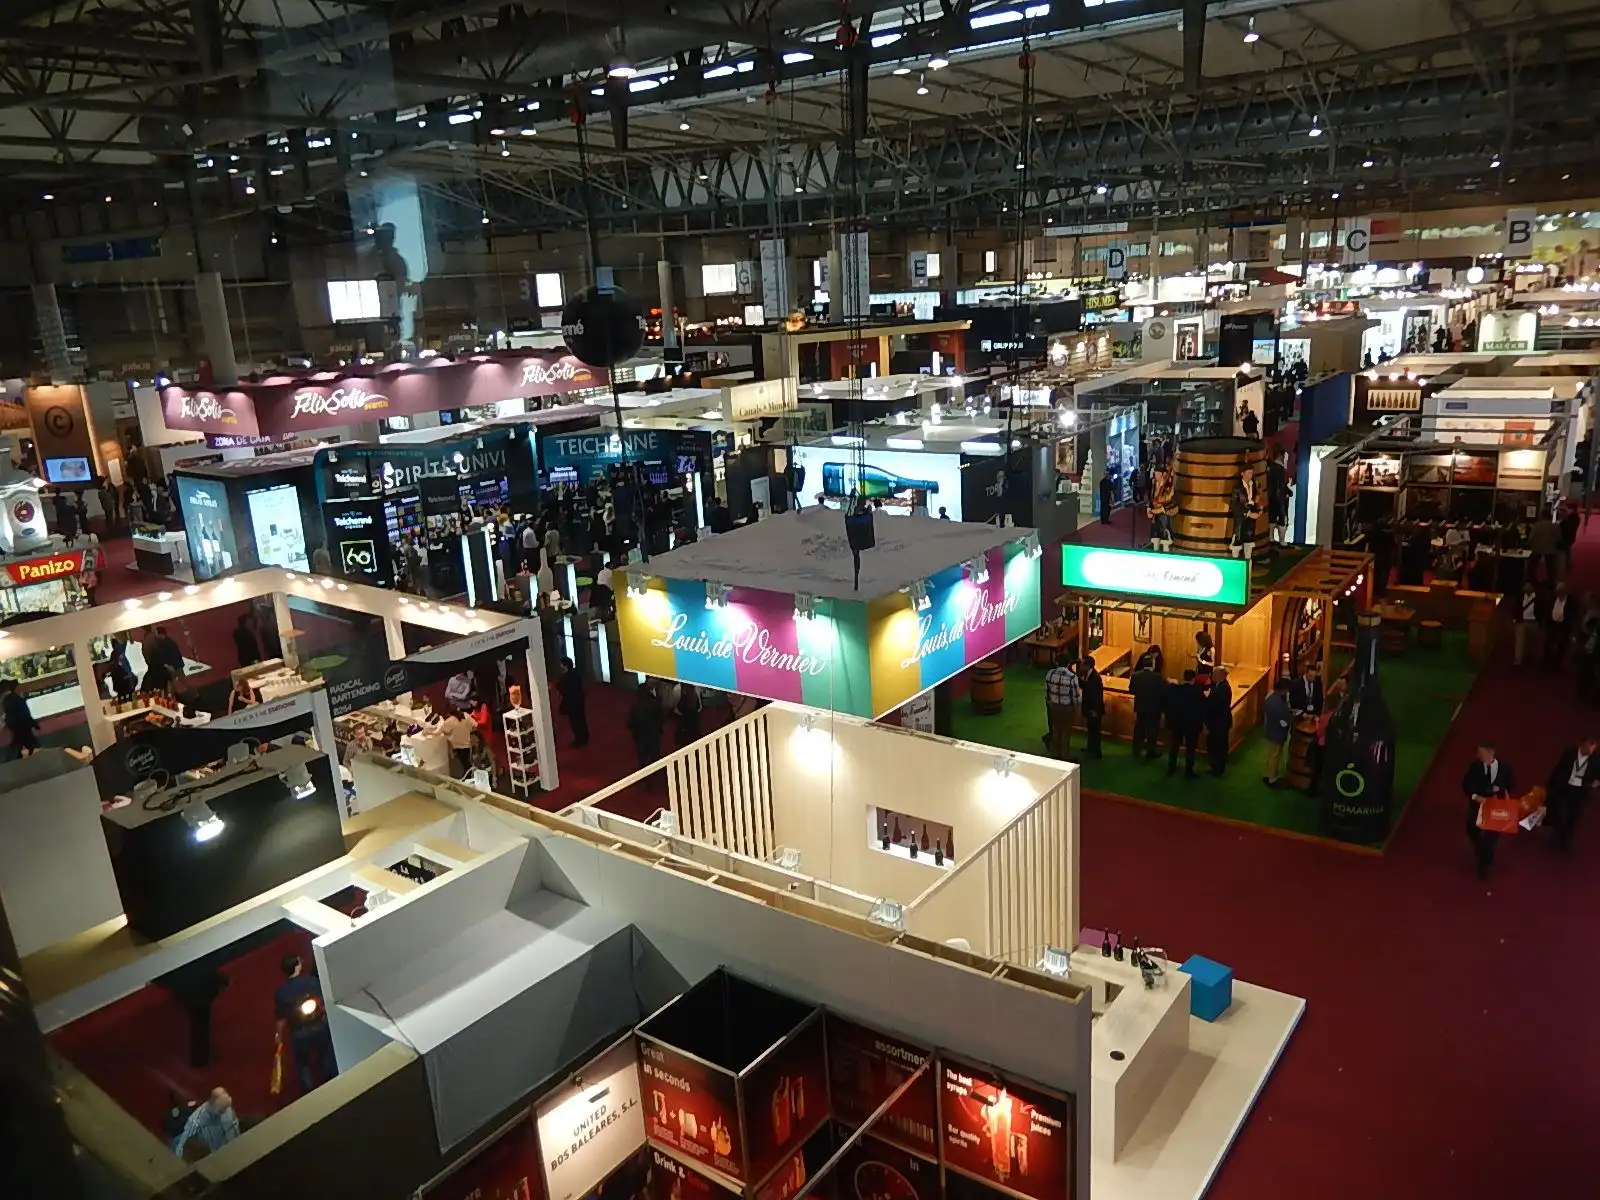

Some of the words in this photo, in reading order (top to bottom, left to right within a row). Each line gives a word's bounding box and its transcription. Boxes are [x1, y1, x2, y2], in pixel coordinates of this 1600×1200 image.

[1347, 230, 1367, 251] C
[1509, 221, 1530, 244] B
[915, 259, 927, 277] E
[1109, 249, 1124, 267] D
[740, 268, 749, 286] G
[19, 559, 75, 580] Panizo
[732, 619, 826, 676] Vernier
[330, 678, 362, 695] RADICAL
[332, 682, 381, 705] BARTENDING
[640, 1042, 665, 1063] Great
[654, 1067, 691, 1093] seconds
[573, 1104, 607, 1137] UNITED
[550, 1149, 570, 1171] BOS
[571, 1110, 621, 1154] BALEARES,
[654, 1151, 677, 1175] Drink
[678, 1165, 686, 1179] &
